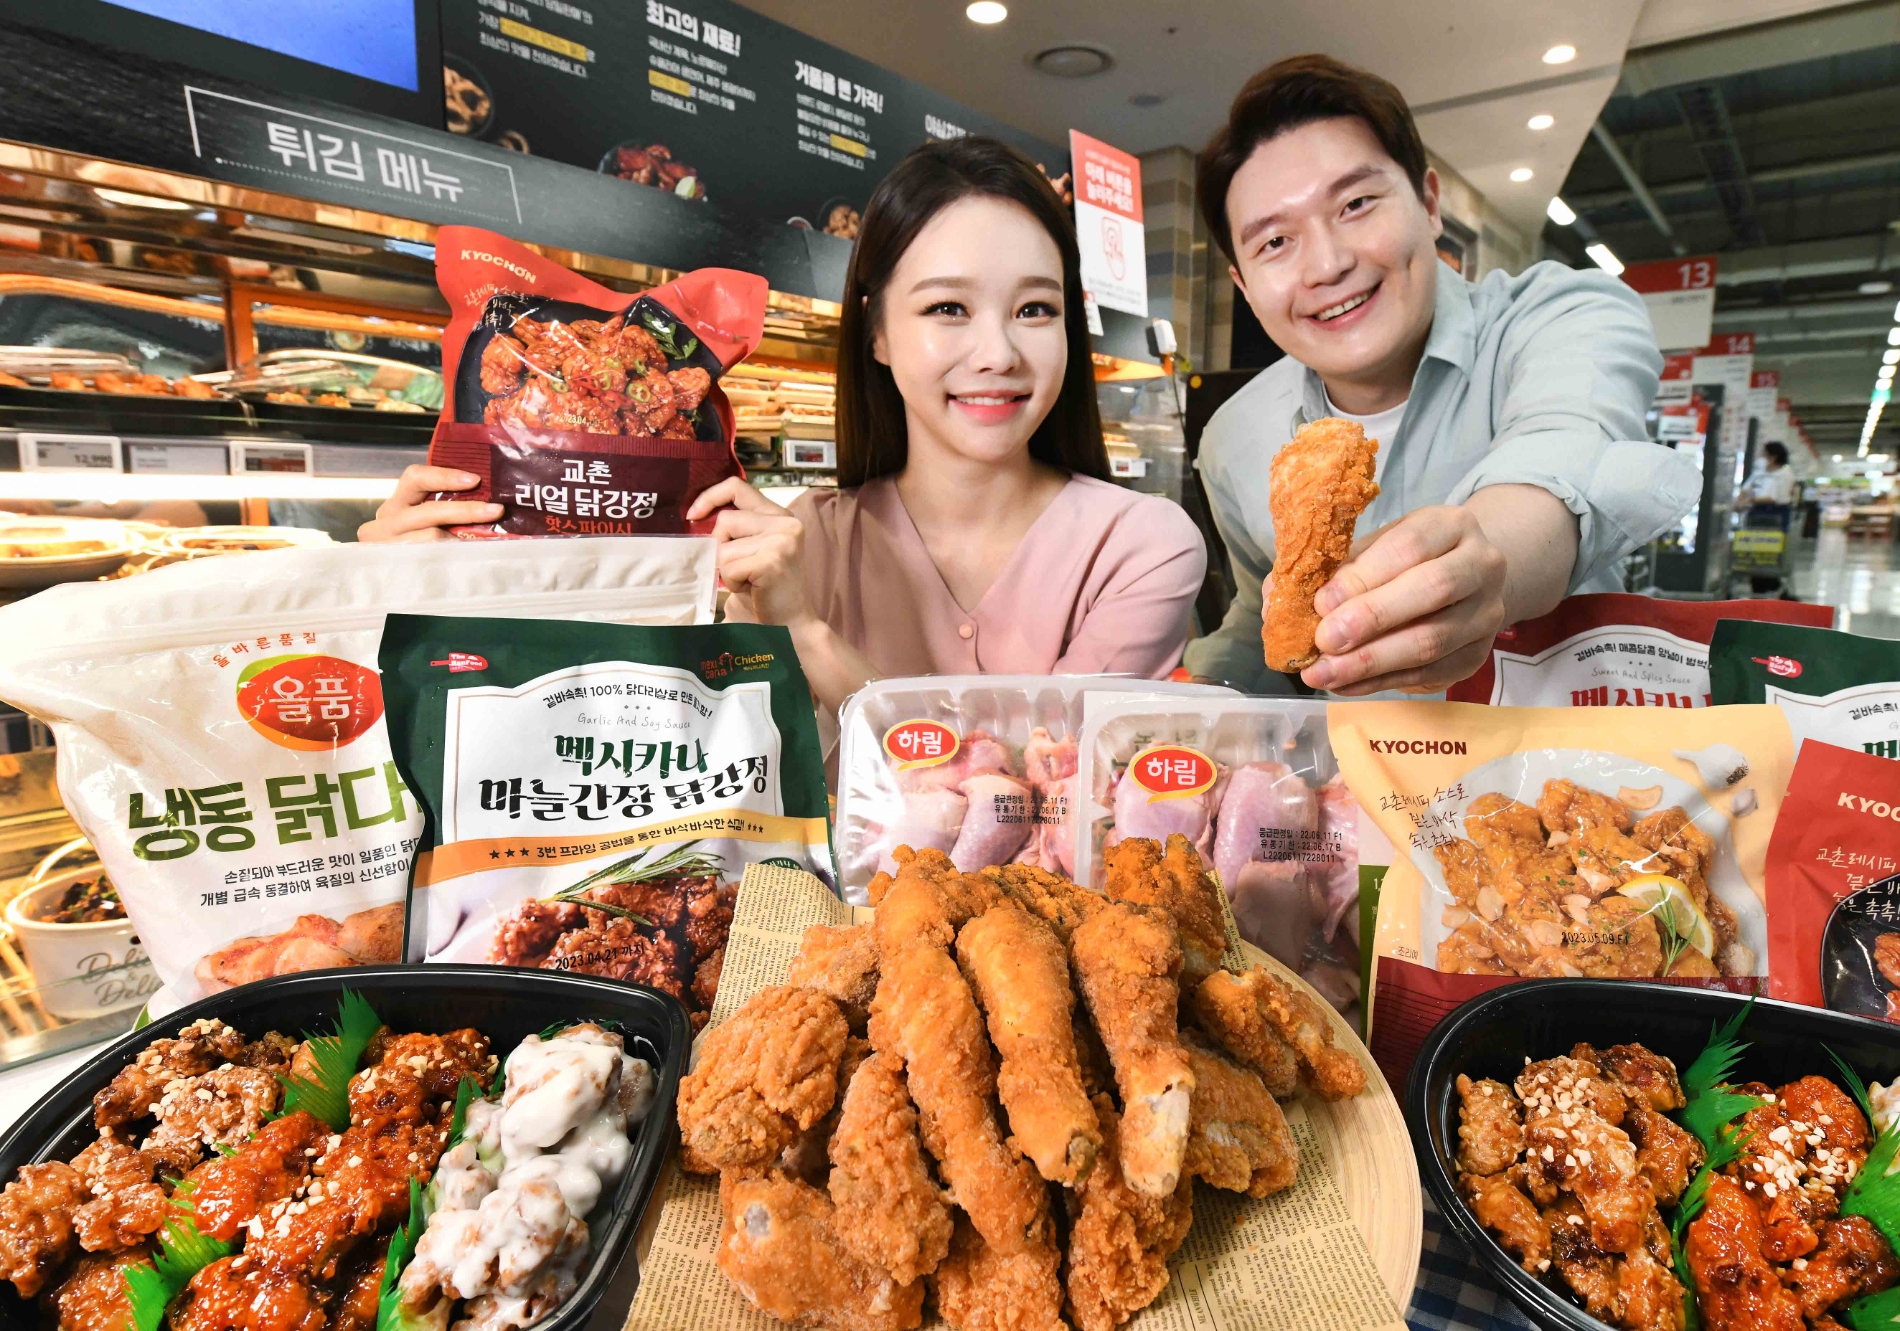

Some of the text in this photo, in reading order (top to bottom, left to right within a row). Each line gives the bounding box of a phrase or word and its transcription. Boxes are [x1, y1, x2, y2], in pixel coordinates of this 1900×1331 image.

[646, 0, 699, 42] 최고의
[702, 20, 741, 57] 재료!
[853, 83, 884, 114] 가격!
[266, 121, 464, 203] 튀김 메뉴
[461, 250, 537, 284] KYOCHON
[1678, 262, 1710, 288] 13
[1727, 336, 1750, 354] 14
[560, 459, 613, 485] 교촌
[515, 484, 658, 519] 리얼 닭강정
[735, 653, 775, 666] Chicken
[1573, 643, 1617, 663] 겉바속촉!
[1618, 642, 1657, 656] 매콤달콤
[1658, 647, 1684, 664] 양념이
[1591, 668, 1619, 677] Sweet
[1622, 669, 1638, 680] And
[1640, 671, 1663, 685] Spicy
[268, 675, 353, 723] 올품
[542, 687, 588, 709] 겉바속촉!
[590, 684, 623, 697] 100%
[626, 683, 678, 701] 닭다리살로
[577, 712, 691, 731] Garlic And Soy Sauce
[1848, 703, 1899, 720] 겉바속촉!
[897, 729, 943, 753] 하림
[1369, 740, 1467, 755] KYOCHON
[554, 734, 709, 779] 멕시카나
[1146, 757, 1196, 785] 하림
[478, 754, 768, 821] 마늘간장 닭강정
[128, 760, 425, 862] 냉동 닭다
[536, 847, 557, 859] 3번
[559, 842, 596, 858] 프라잉
[599, 836, 635, 850] 공법을
[638, 828, 662, 842] 통한
[664, 818, 725, 835] 바삭바삭한
[224, 865, 274, 885] 손질되어
[276, 856, 325, 877] 부드러운
[328, 852, 355, 869] 맛이
[358, 844, 397, 862] 일품인
[200, 858, 410, 907] 개별 급속 동결하여 육질의 신선함이
[621, 942, 645, 957] 까지
[1397, 946, 1418, 960] 조리예
[677, 1224, 687, 1244] horse
[685, 1231, 694, 1246] with
[638, 1247, 663, 1315] repressed little world
[651, 1274, 663, 1302] magazine
